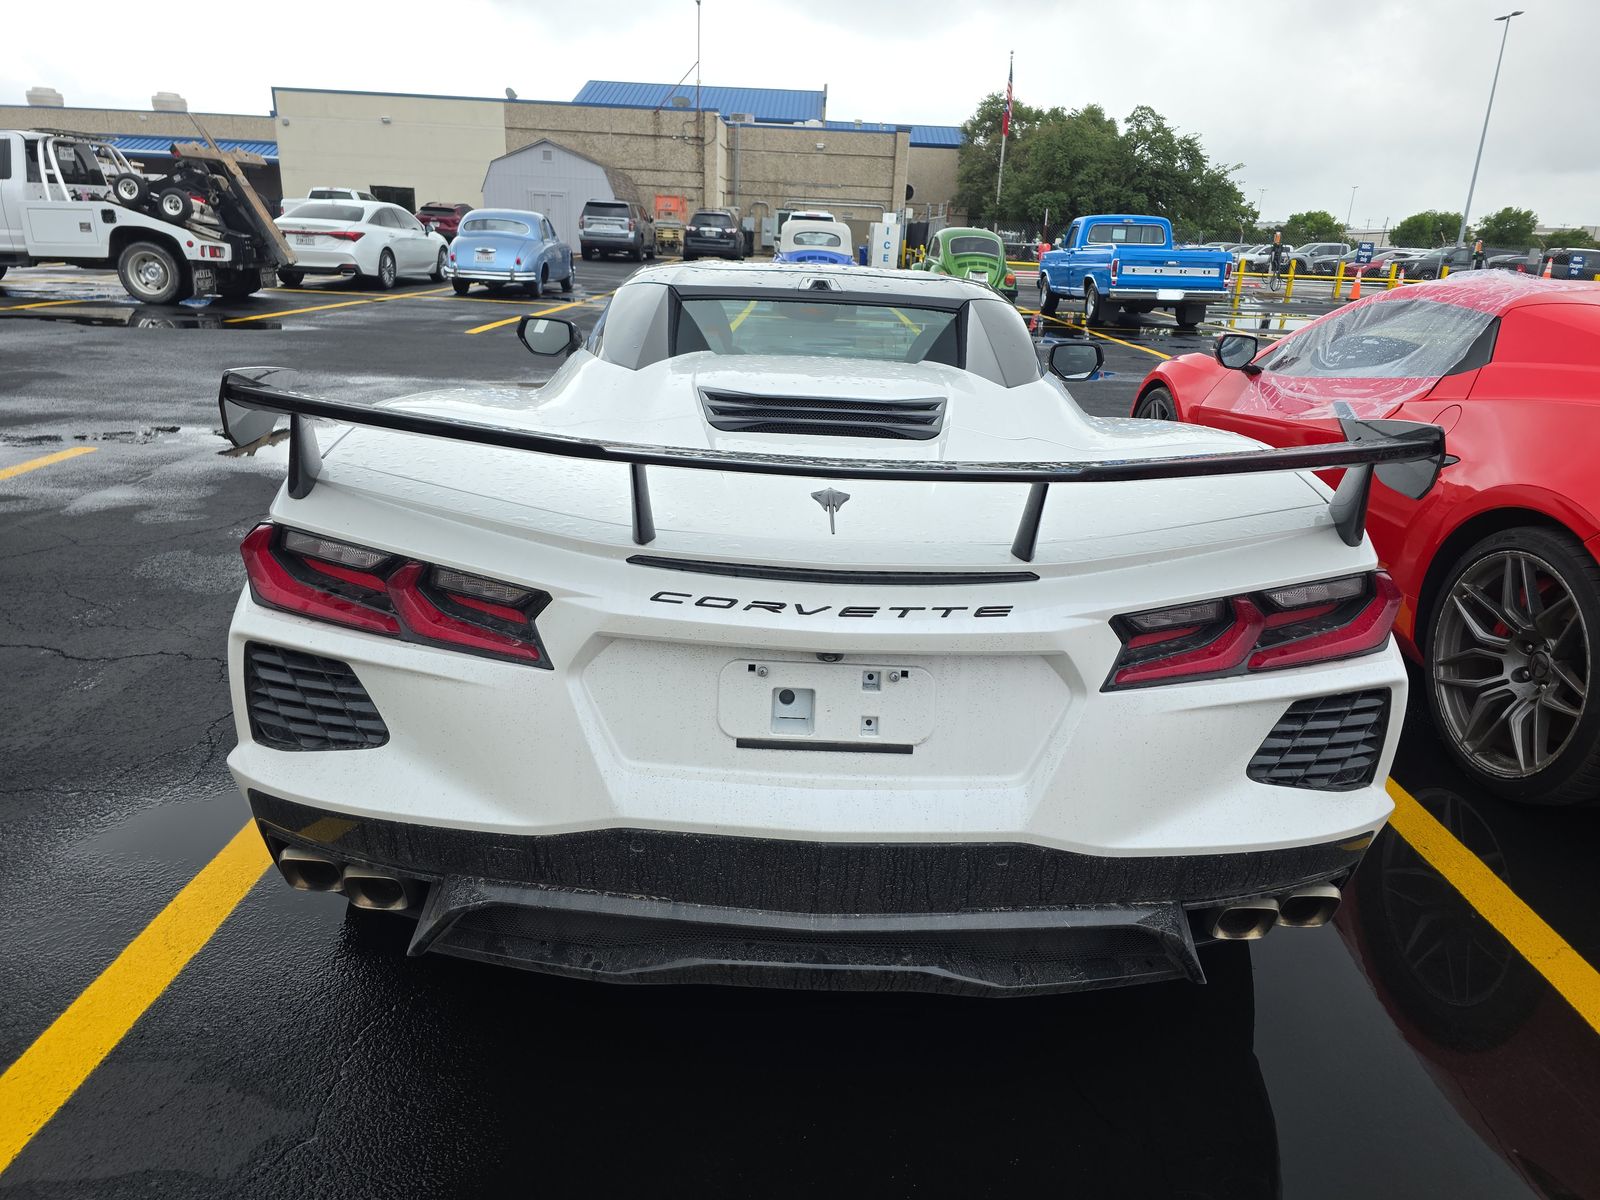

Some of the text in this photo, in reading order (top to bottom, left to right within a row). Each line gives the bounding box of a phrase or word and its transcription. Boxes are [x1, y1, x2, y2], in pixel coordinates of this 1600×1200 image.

[882, 226, 891, 263] ICE
[1132, 267, 1211, 275] FORD
[650, 591, 1014, 618] CORVETTE
